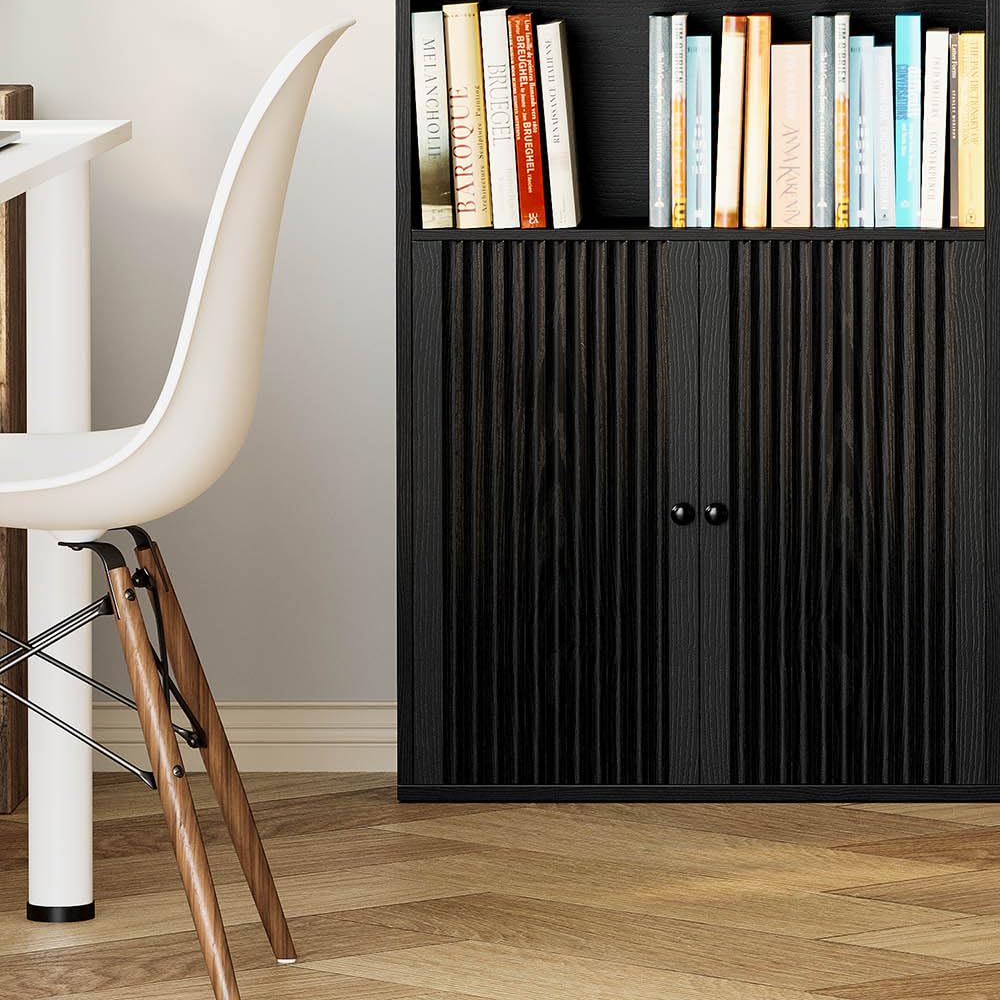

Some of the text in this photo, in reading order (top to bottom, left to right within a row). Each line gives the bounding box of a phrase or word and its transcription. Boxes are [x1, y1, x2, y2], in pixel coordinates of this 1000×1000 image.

[516, 35, 527, 87] BREUGHEL
[897, 64, 908, 120] CONVERSATIONS
[423, 38, 441, 160] MELANCHOLIE
[488, 64, 510, 146] BRUEGEL
[449, 86, 476, 213] BAROQUE
[523, 122, 534, 173] BRUEGHEL
